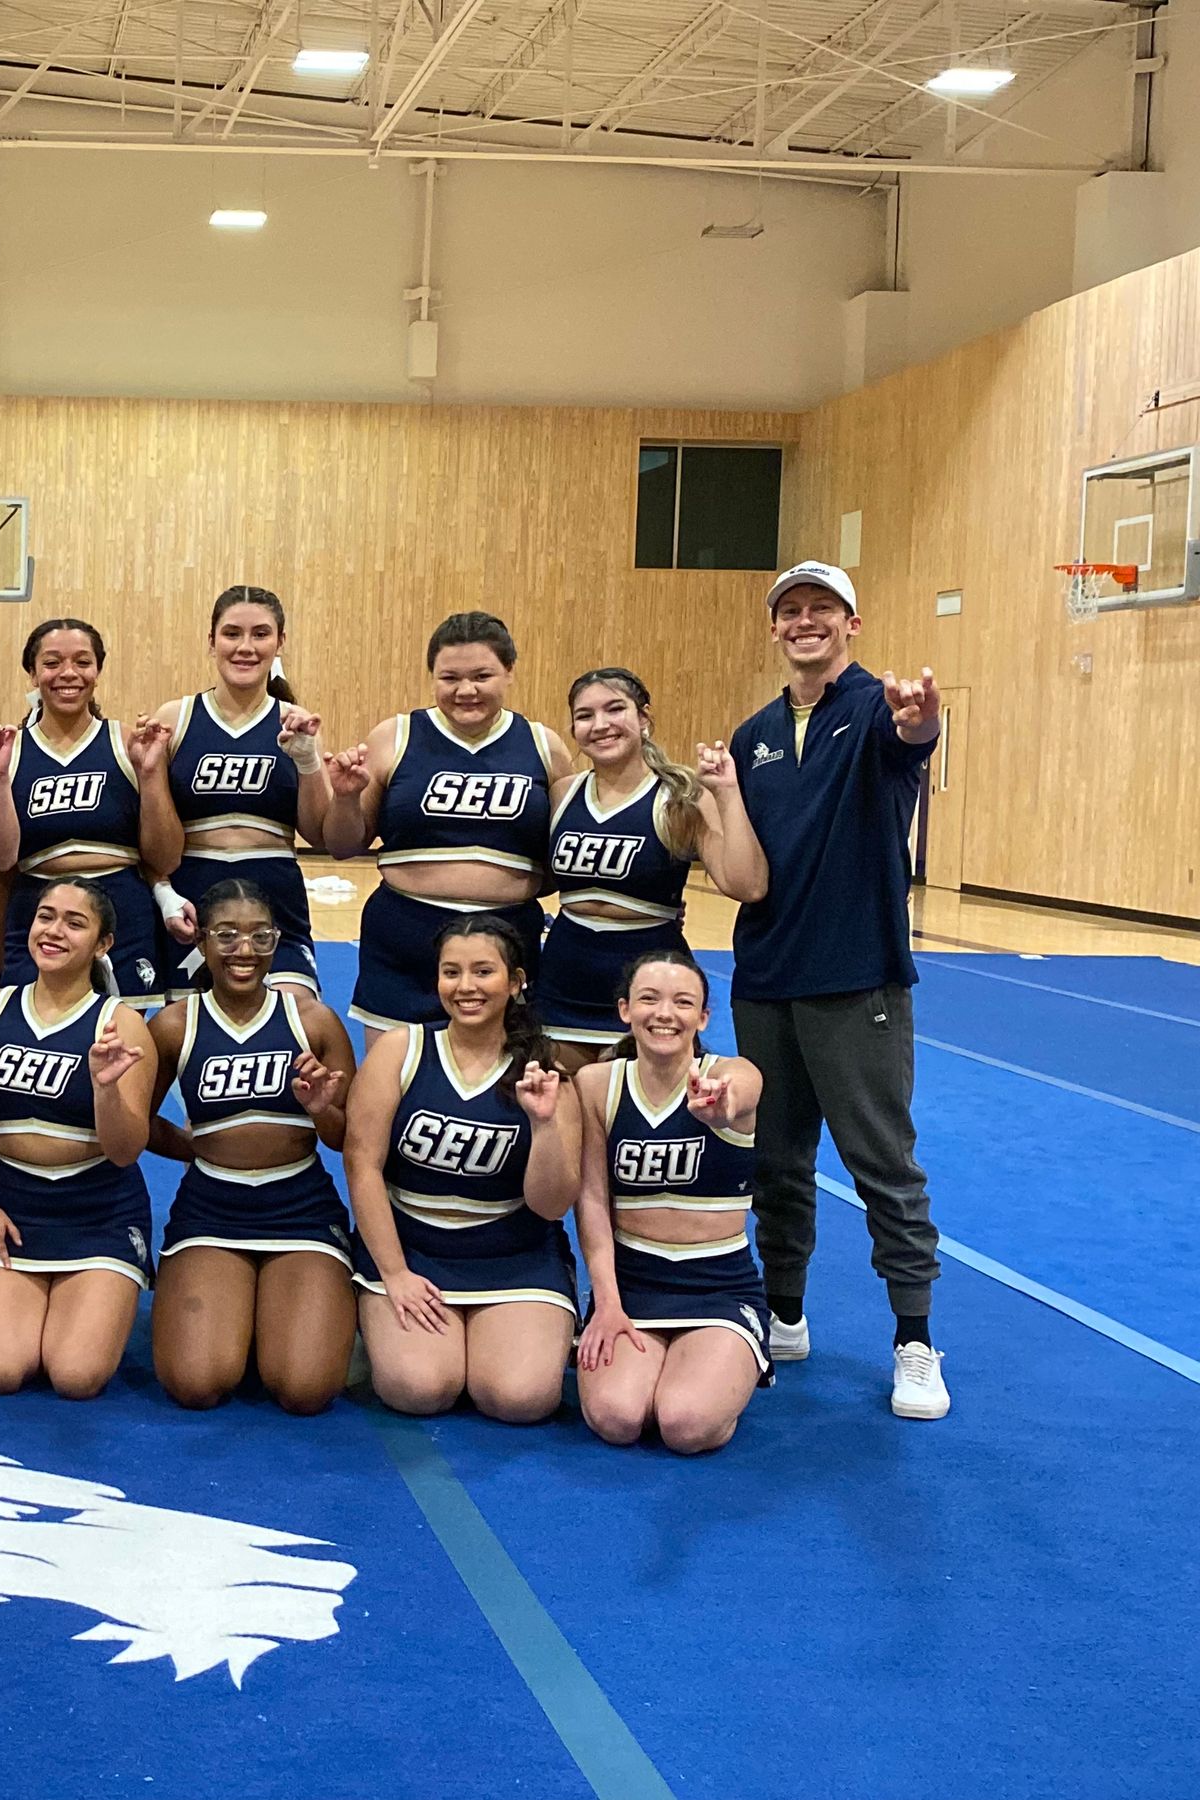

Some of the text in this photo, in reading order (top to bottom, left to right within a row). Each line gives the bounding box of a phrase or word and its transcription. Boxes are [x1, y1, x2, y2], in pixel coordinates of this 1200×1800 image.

[29, 771, 107, 818] SEU
[191, 753, 277, 794] SEU
[420, 771, 532, 820] SEU
[552, 832, 646, 880] SEU
[197, 1051, 292, 1103] SEU
[398, 1109, 520, 1176] SEU
[614, 1136, 706, 1186] SEU
